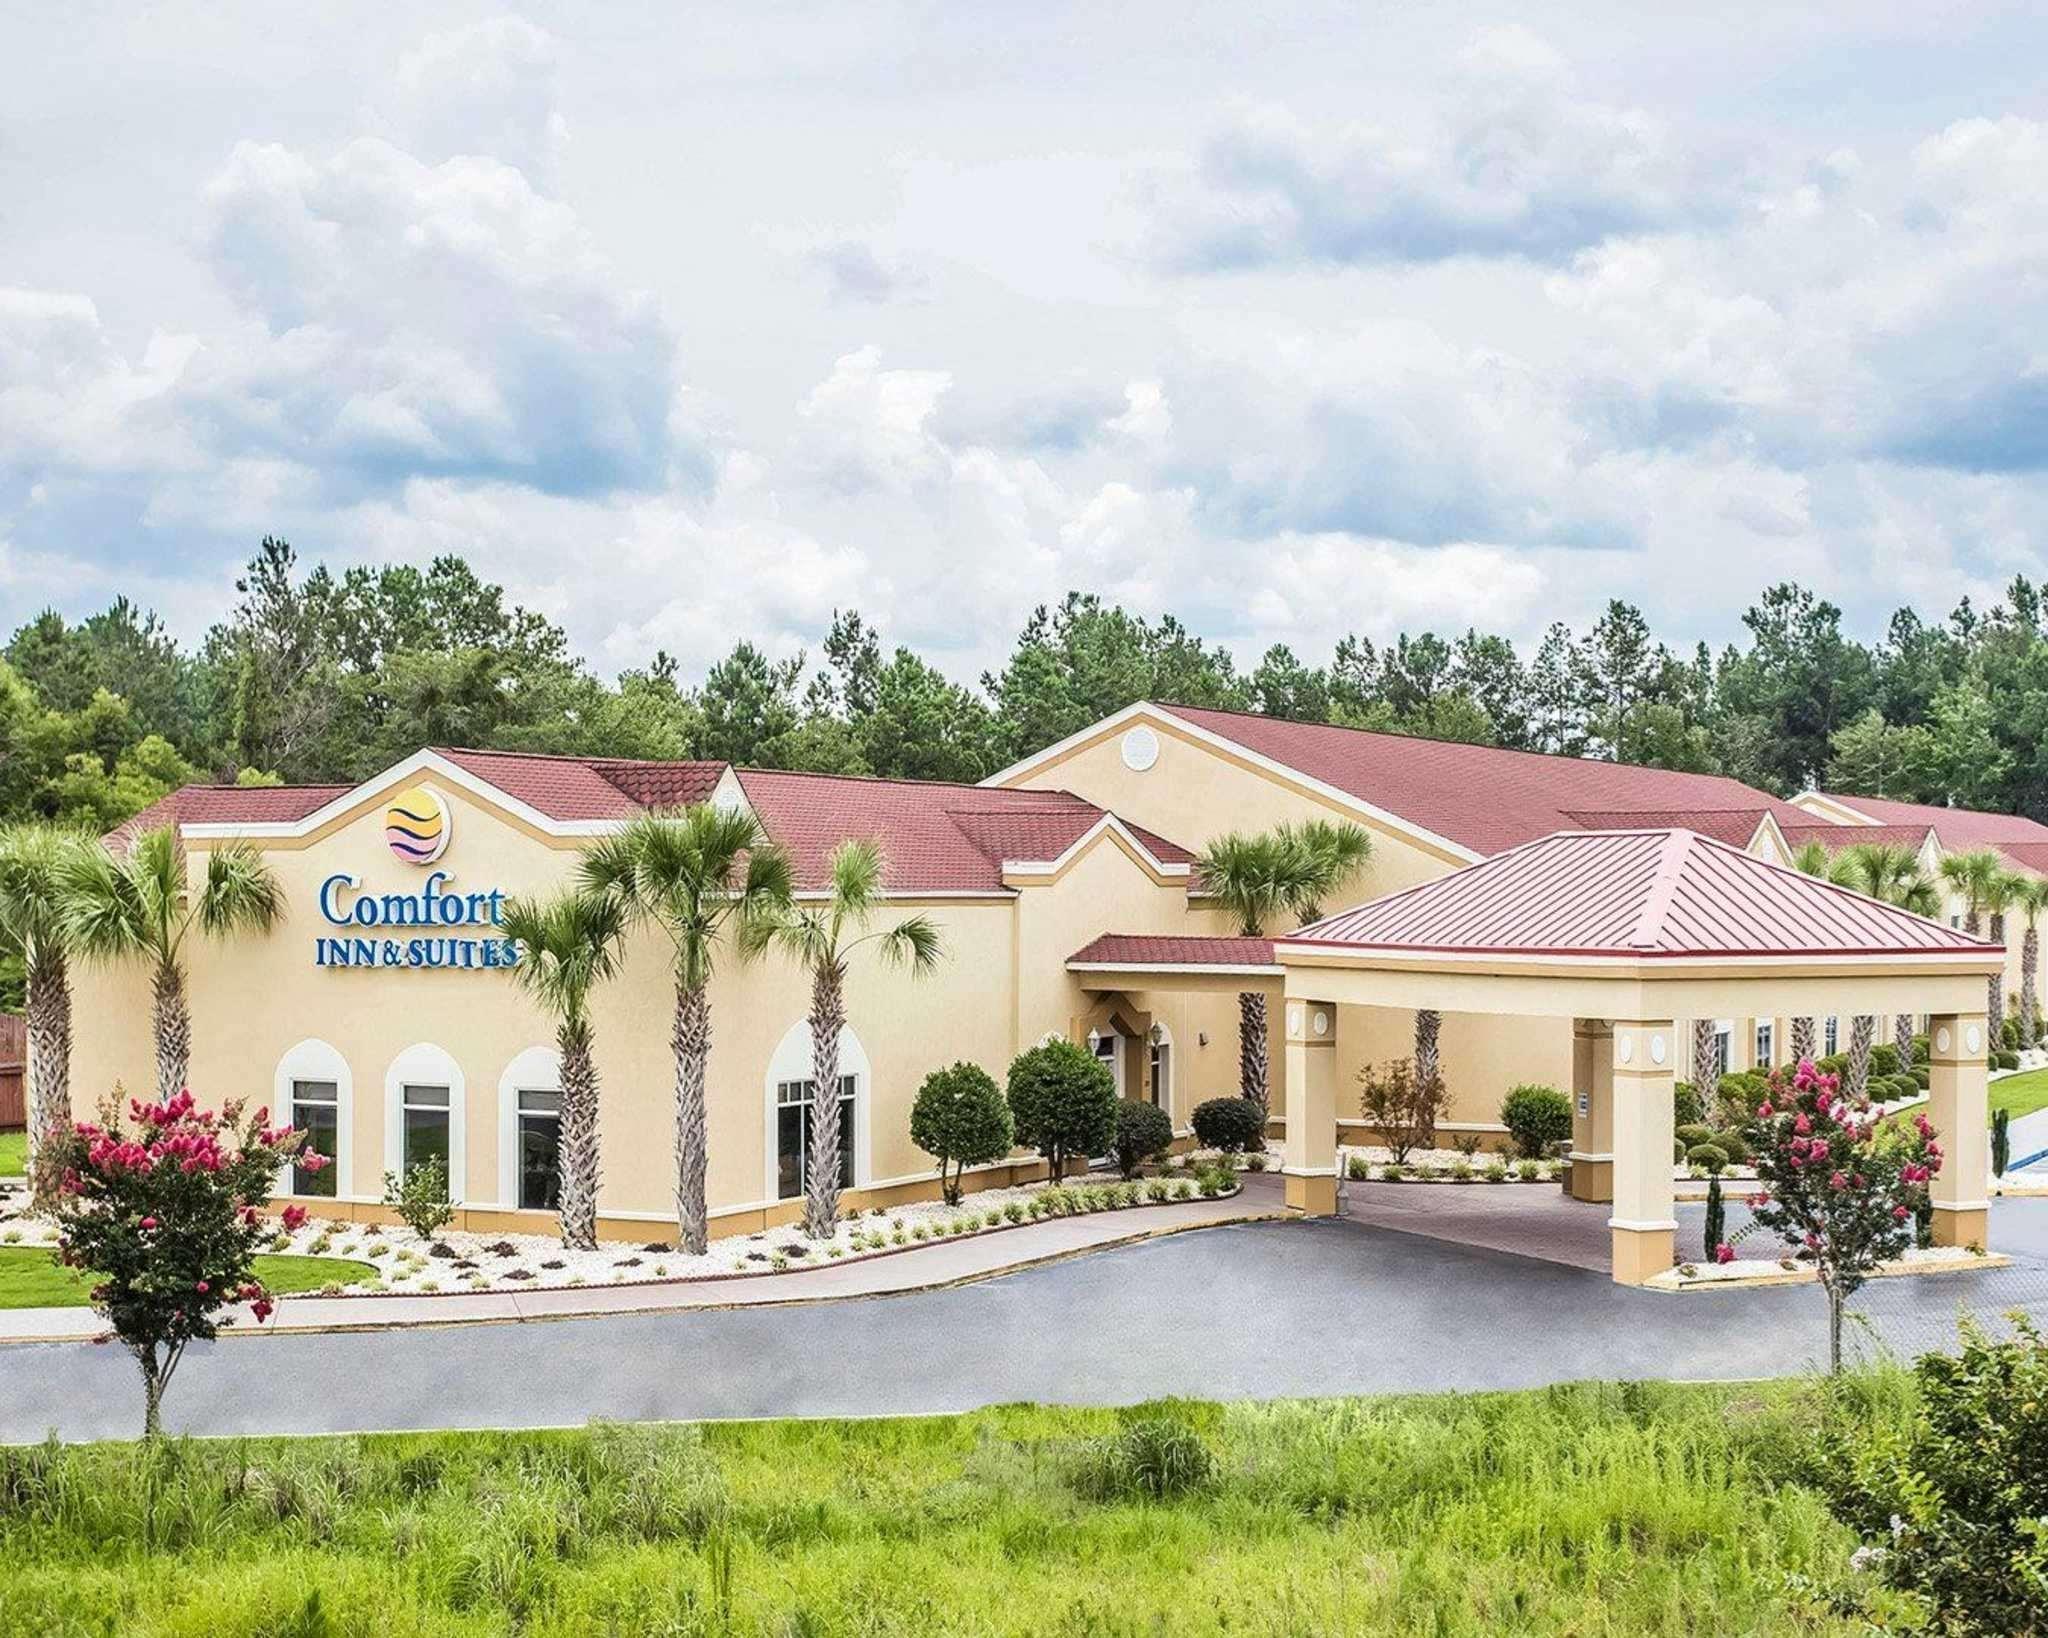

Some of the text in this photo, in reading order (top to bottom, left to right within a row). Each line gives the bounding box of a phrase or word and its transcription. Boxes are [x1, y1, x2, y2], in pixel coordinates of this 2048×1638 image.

[319, 871, 507, 926] Comfort
[316, 938, 520, 968] INN & SUITES
